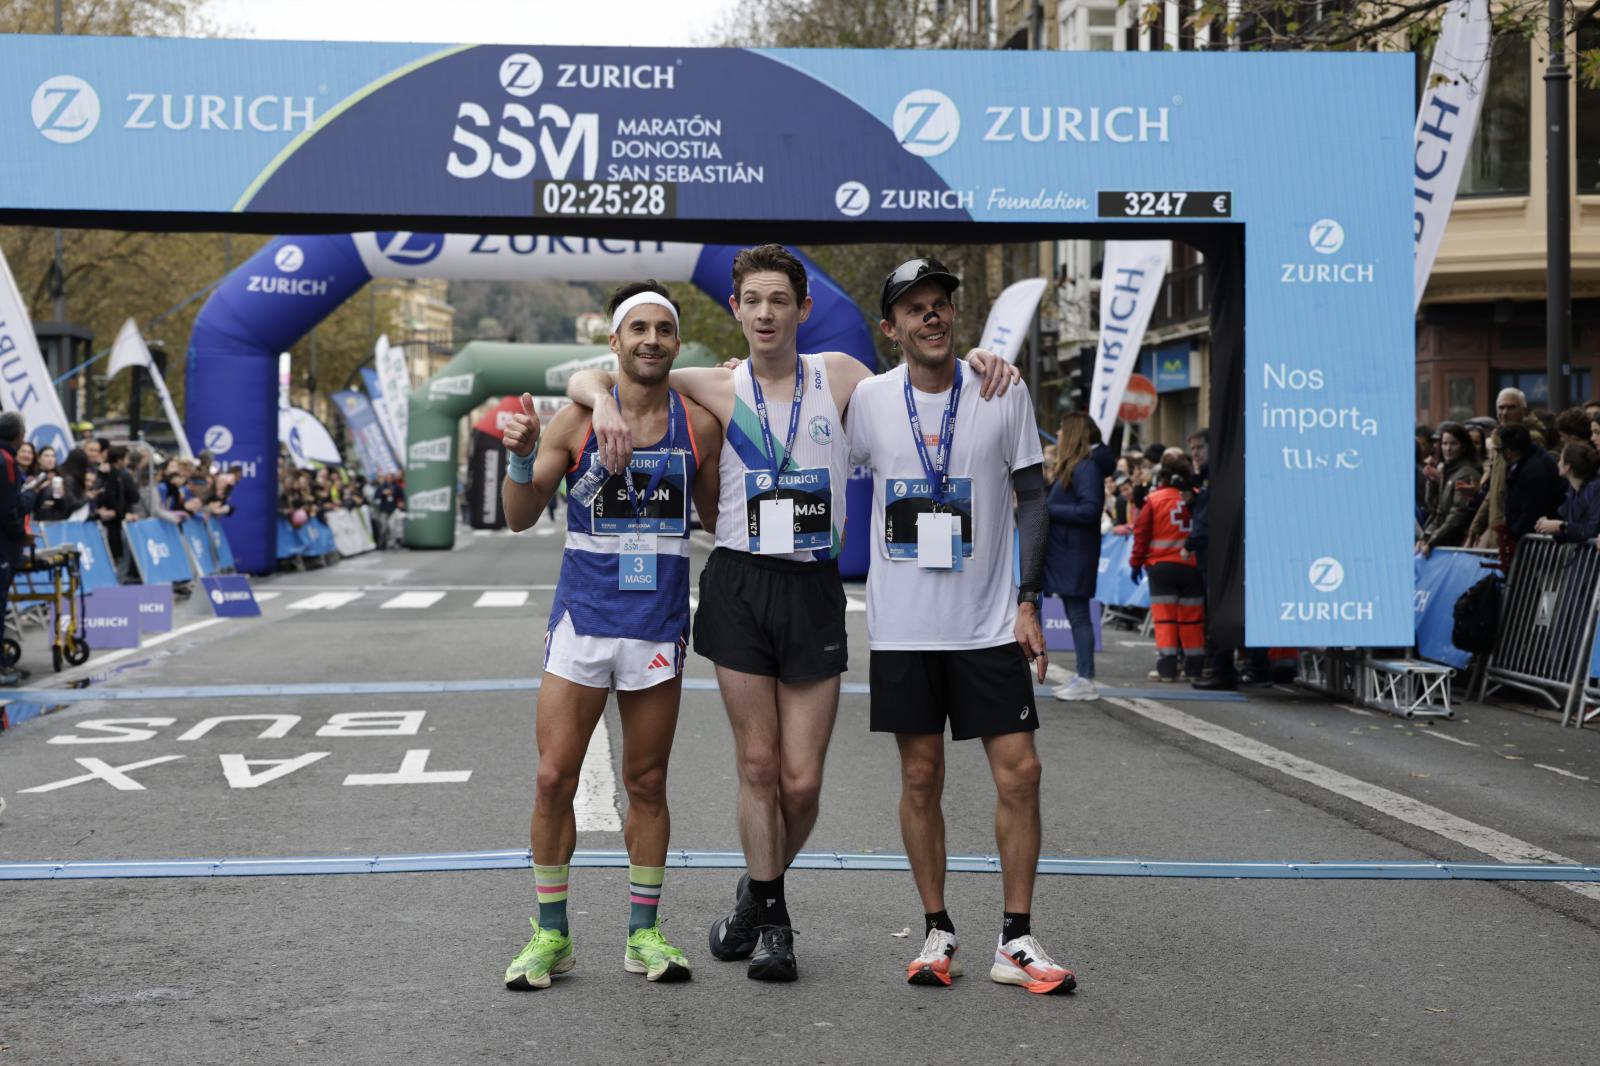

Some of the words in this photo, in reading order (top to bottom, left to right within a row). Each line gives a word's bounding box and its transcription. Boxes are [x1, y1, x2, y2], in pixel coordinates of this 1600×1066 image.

[557, 64, 676, 89] ZURICH
[123, 93, 316, 132] ZURICH
[984, 106, 1170, 142] ZURICH
[617, 115, 722, 137] MARATÓN
[446, 102, 600, 181] SSM
[611, 139, 723, 159] DONOSTIA
[607, 164, 650, 182] SAN
[654, 162, 765, 184] SEBASTIÁN
[542, 182, 666, 215] 02:25:28
[880, 188, 975, 210] ZURICH
[985, 186, 1091, 212] Foundation
[1124, 191, 1188, 216] 3247
[1212, 194, 1228, 214] €
[1280, 263, 1374, 283] ZURICH
[246, 275, 328, 297] ZURICH
[1263, 363, 1325, 391] Nos
[1262, 402, 1378, 436] importa
[777, 474, 819, 485] ZURICH
[792, 503, 826, 516] MAS
[633, 557, 644, 573] 3
[624, 575, 652, 584] MASC
[1280, 602, 1373, 621] ZURICH
[46, 710, 427, 744] BUS
